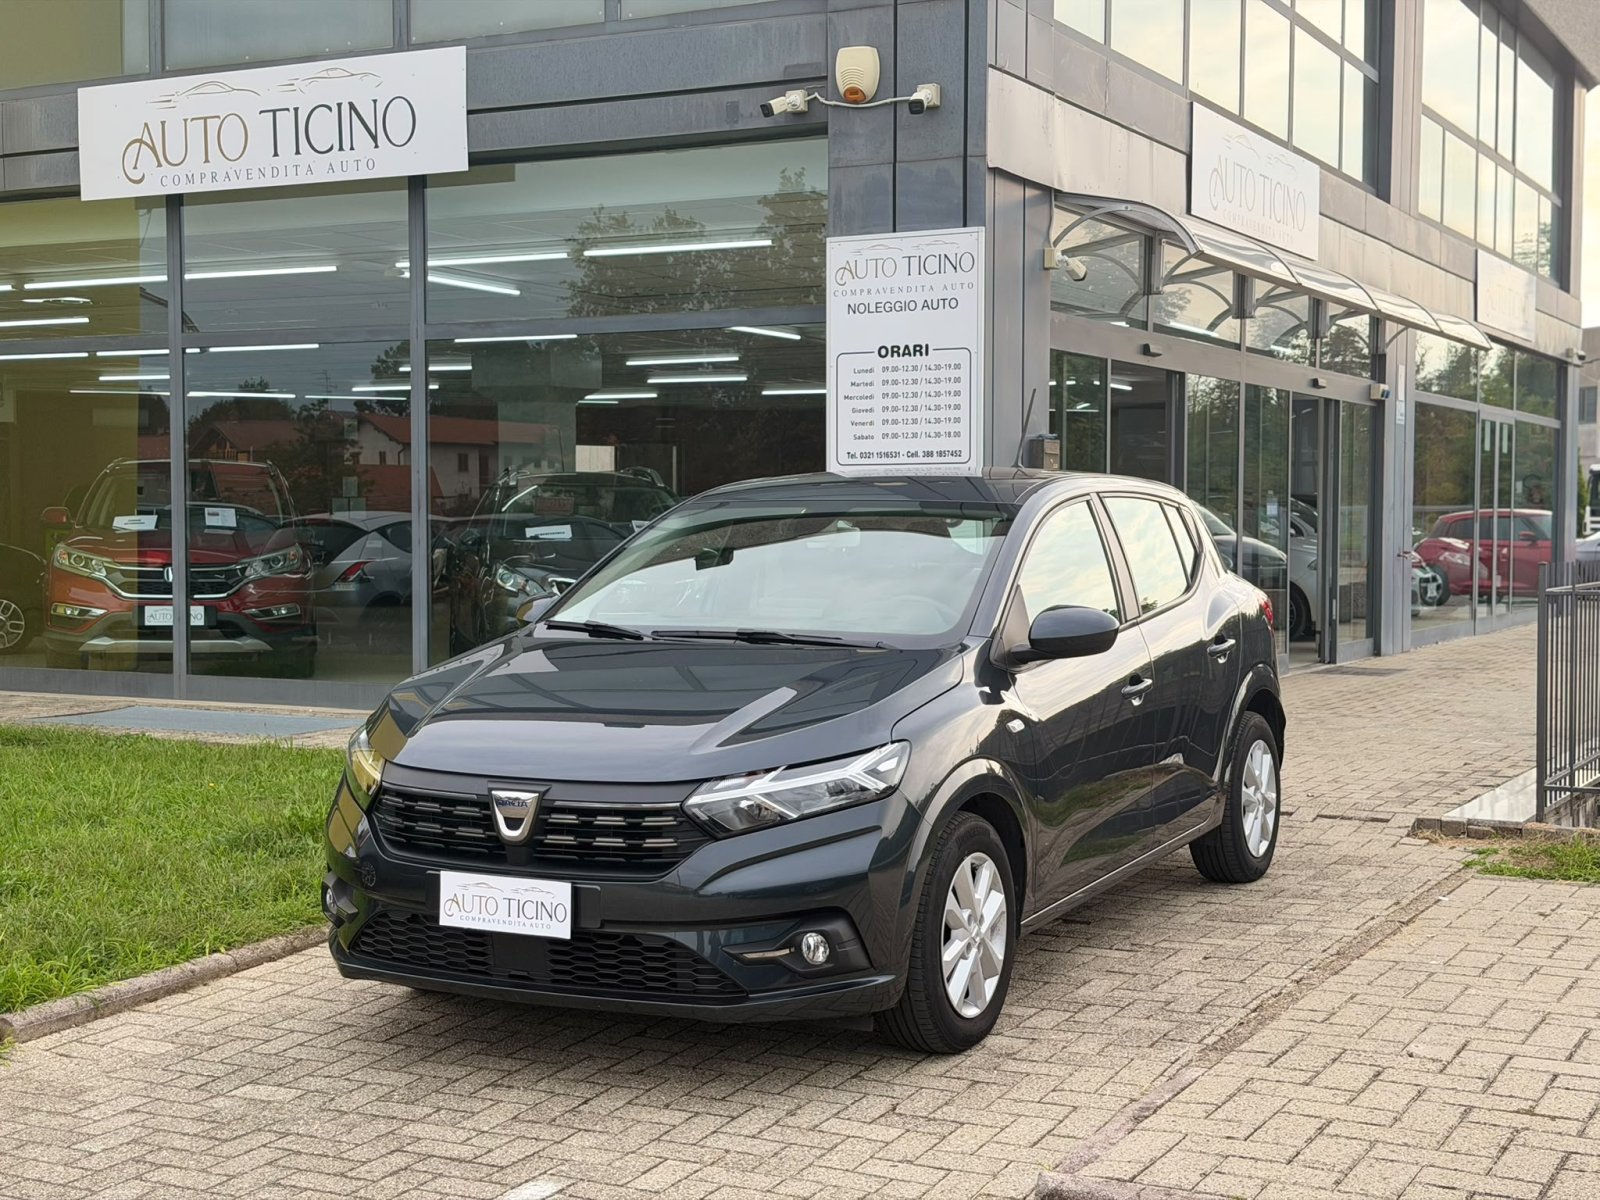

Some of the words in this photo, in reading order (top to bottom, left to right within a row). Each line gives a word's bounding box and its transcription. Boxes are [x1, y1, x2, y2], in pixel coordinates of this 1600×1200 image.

[122, 112, 249, 185] AUTO
[258, 96, 417, 158] TICINO
[160, 163, 315, 188] COMPRAVENDITA
[326, 157, 376, 174] AUTO
[1209, 154, 1256, 212] AUTO
[1259, 173, 1306, 232] TICINO
[834, 256, 897, 287] AUTO
[902, 251, 975, 276] TICINO
[833, 284, 935, 298] COMPRAVENDITA
[942, 281, 974, 292] AUTO
[847, 299, 918, 315] NOLEGGIO
[921, 297, 959, 311] AUTO
[877, 343, 929, 359] ORARI
[881, 364, 919, 373] 09.00-12.30
[924, 363, 961, 371] 14.30-19.00
[881, 378, 919, 387] 09.00-12.30
[924, 376, 961, 385] 14.30-19.00
[881, 391, 919, 400] 09.00-12.30
[924, 390, 961, 398] 14.30-19.00
[881, 405, 919, 413] 09.00-12.30
[924, 403, 961, 411] 14.30-19.00
[881, 418, 919, 426] 09.00-12.30
[924, 416, 961, 425] 14.30-19.00
[853, 433, 875, 441] Sabato
[881, 432, 919, 440] 09.00-12.30
[924, 430, 961, 439] 14.30-18.00
[846, 451, 858, 459] Tel.
[860, 451, 874, 459] 0321
[876, 451, 901, 459] 1516531
[906, 450, 920, 458] Cell.
[922, 450, 934, 458] 388
[443, 893, 499, 917] AUTO
[502, 897, 568, 923] TICINO
[459, 914, 527, 928] COMPRAVENDITA
[529, 922, 552, 930] AUTO
